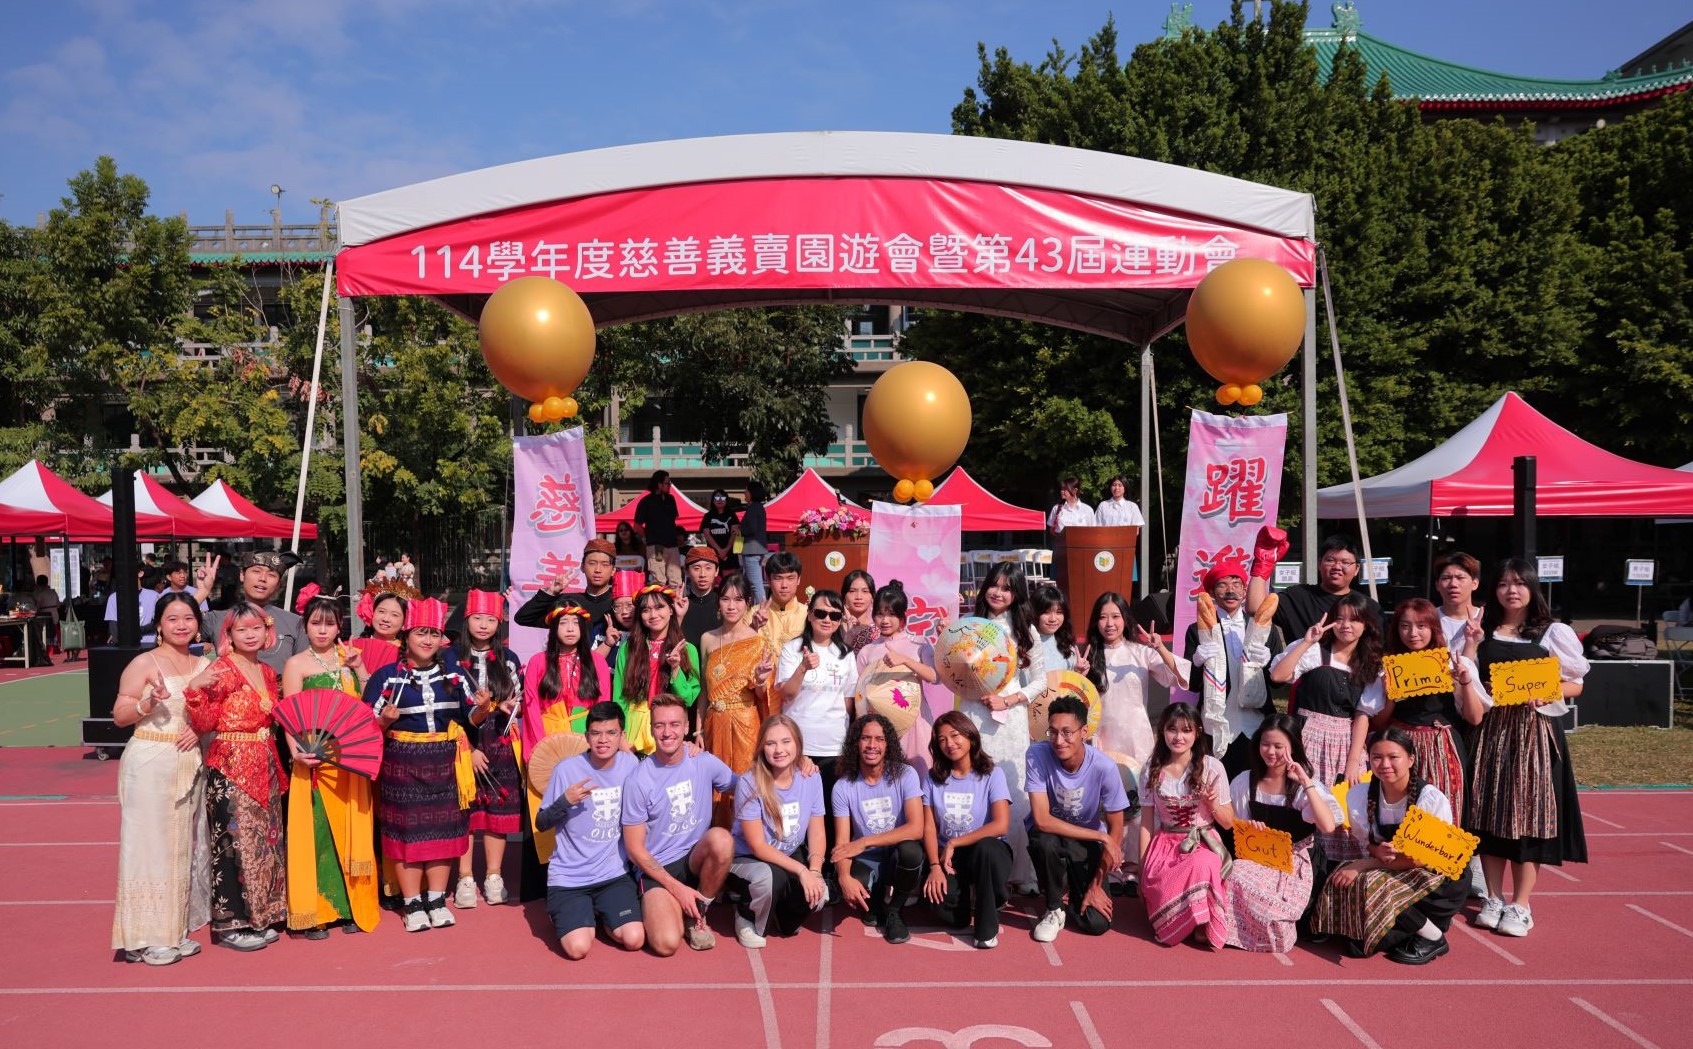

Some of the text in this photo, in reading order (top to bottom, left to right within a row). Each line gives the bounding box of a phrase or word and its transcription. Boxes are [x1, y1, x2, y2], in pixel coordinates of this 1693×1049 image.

[410, 232, 1240, 282] 114學年度慈善義賣園遊會暨第43屆運動會
[1391, 665, 1443, 689] Prima
[1505, 675, 1548, 697] Super
[1245, 834, 1278, 858] Gut
